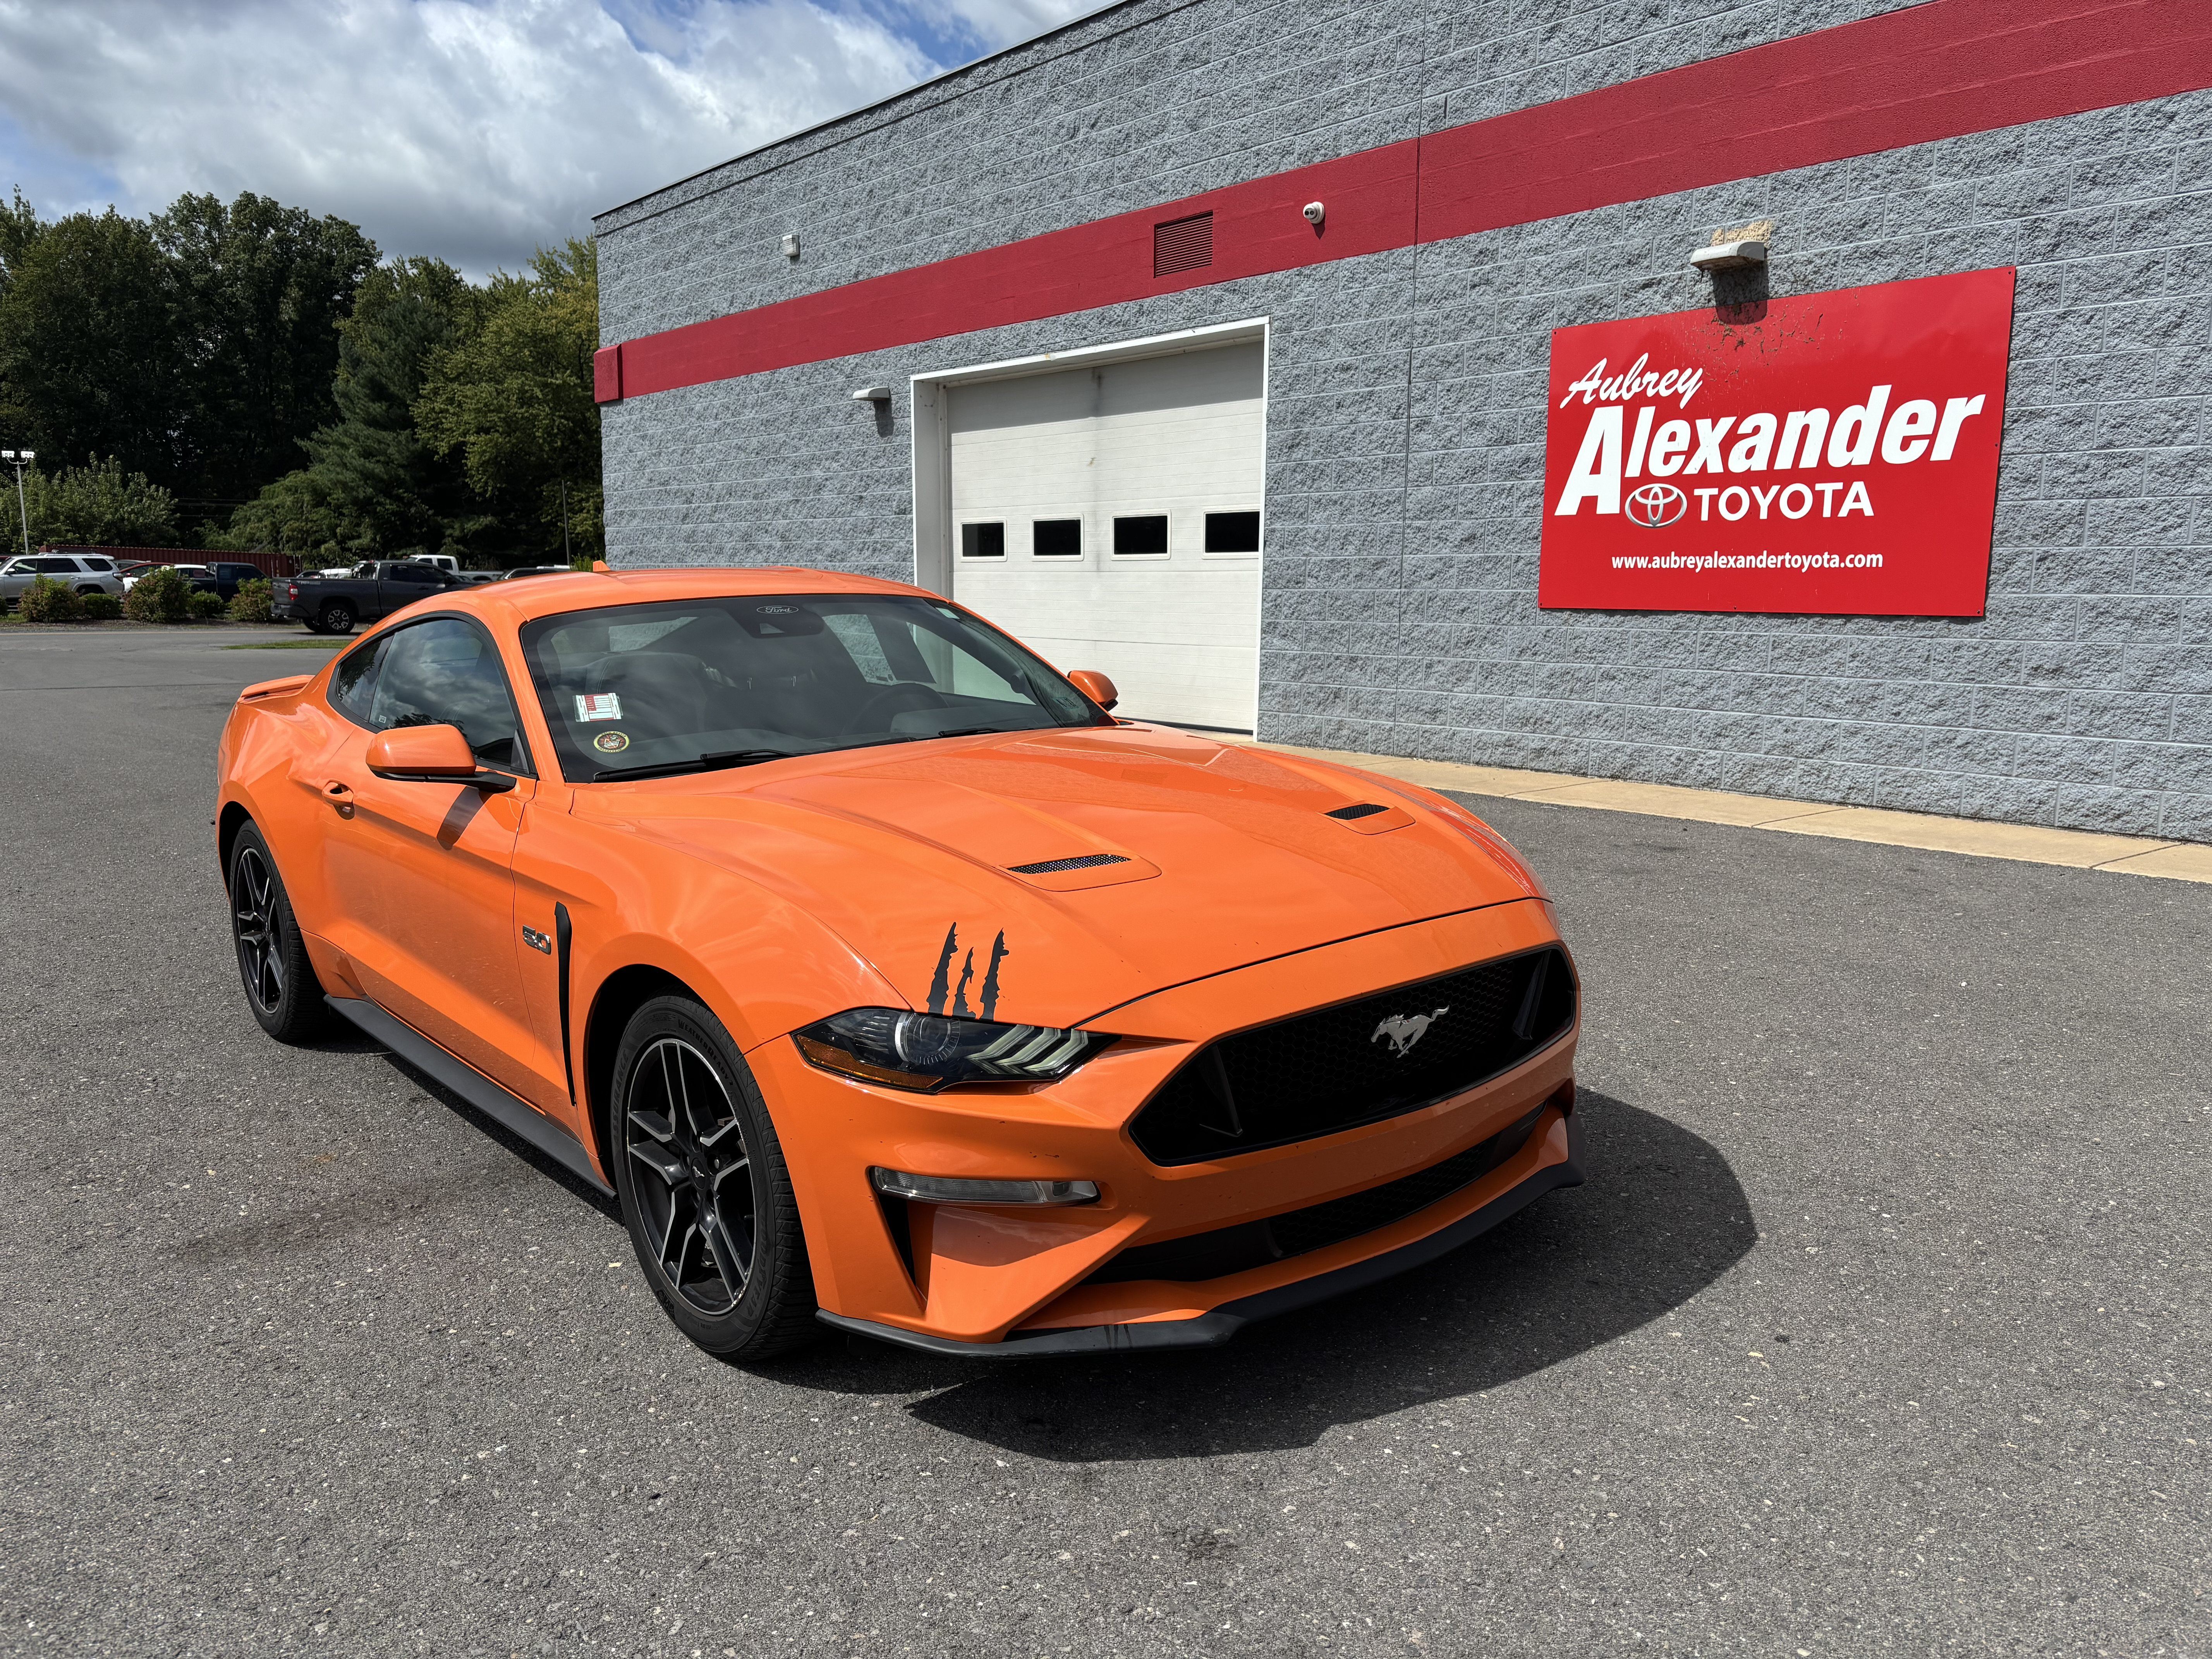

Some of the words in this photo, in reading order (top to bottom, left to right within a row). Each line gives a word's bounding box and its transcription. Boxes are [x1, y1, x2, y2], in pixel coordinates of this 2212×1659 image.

[1560, 353, 1703, 409] Aubrey
[1554, 385, 1986, 516] Alexander
[1694, 481, 1874, 521] TOYOTA
[1612, 551, 1883, 573] www.aubreyalexandertoyota.com
[522, 924, 551, 955] 5.0
[612, 1049, 629, 1146] ASSURANCE
